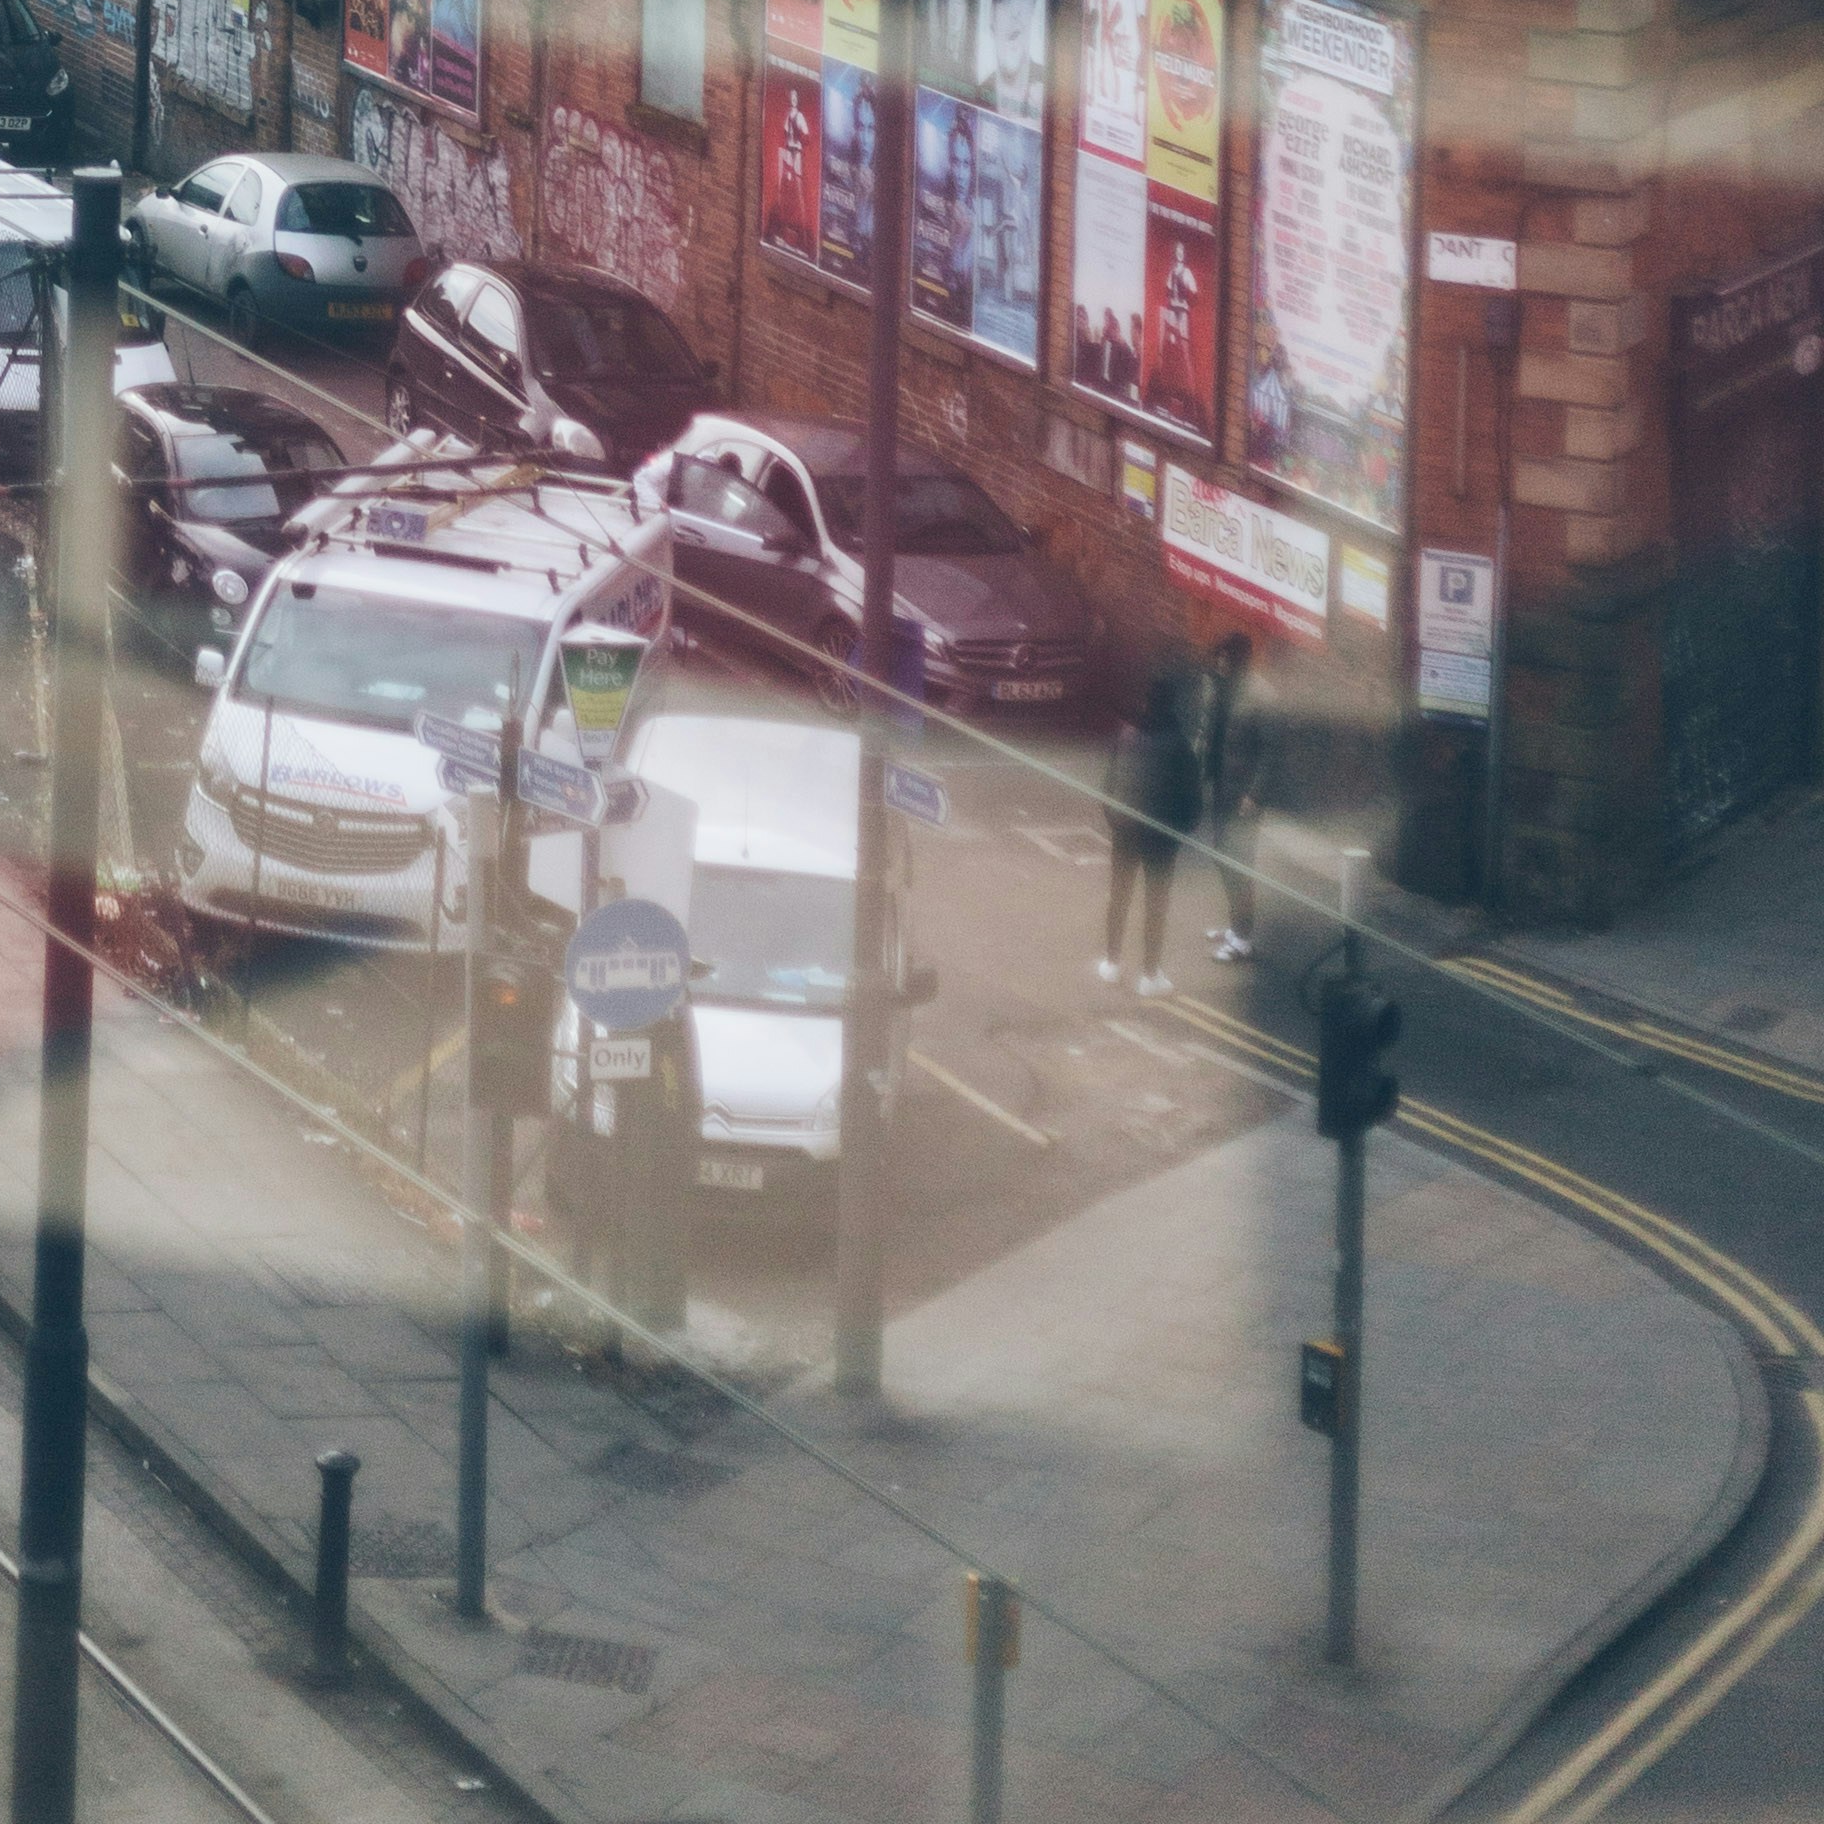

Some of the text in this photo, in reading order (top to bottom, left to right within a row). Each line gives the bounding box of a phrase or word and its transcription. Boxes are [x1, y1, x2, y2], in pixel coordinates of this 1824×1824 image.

[1295, 2, 1385, 46] NEIGHBOURHOOD
[1286, 18, 1391, 76] WEEKENDER
[1154, 49, 1216, 90] FIELD MUSIC
[1278, 109, 1330, 143] george
[1342, 133, 1392, 168] RICHARD
[1338, 154, 1396, 188] ASHCROFT
[1170, 476, 1326, 599] Barca News
[587, 648, 619, 669] Pay
[579, 669, 624, 688] Here
[271, 762, 403, 798] BARLOWS
[594, 1047, 647, 1071] Only
